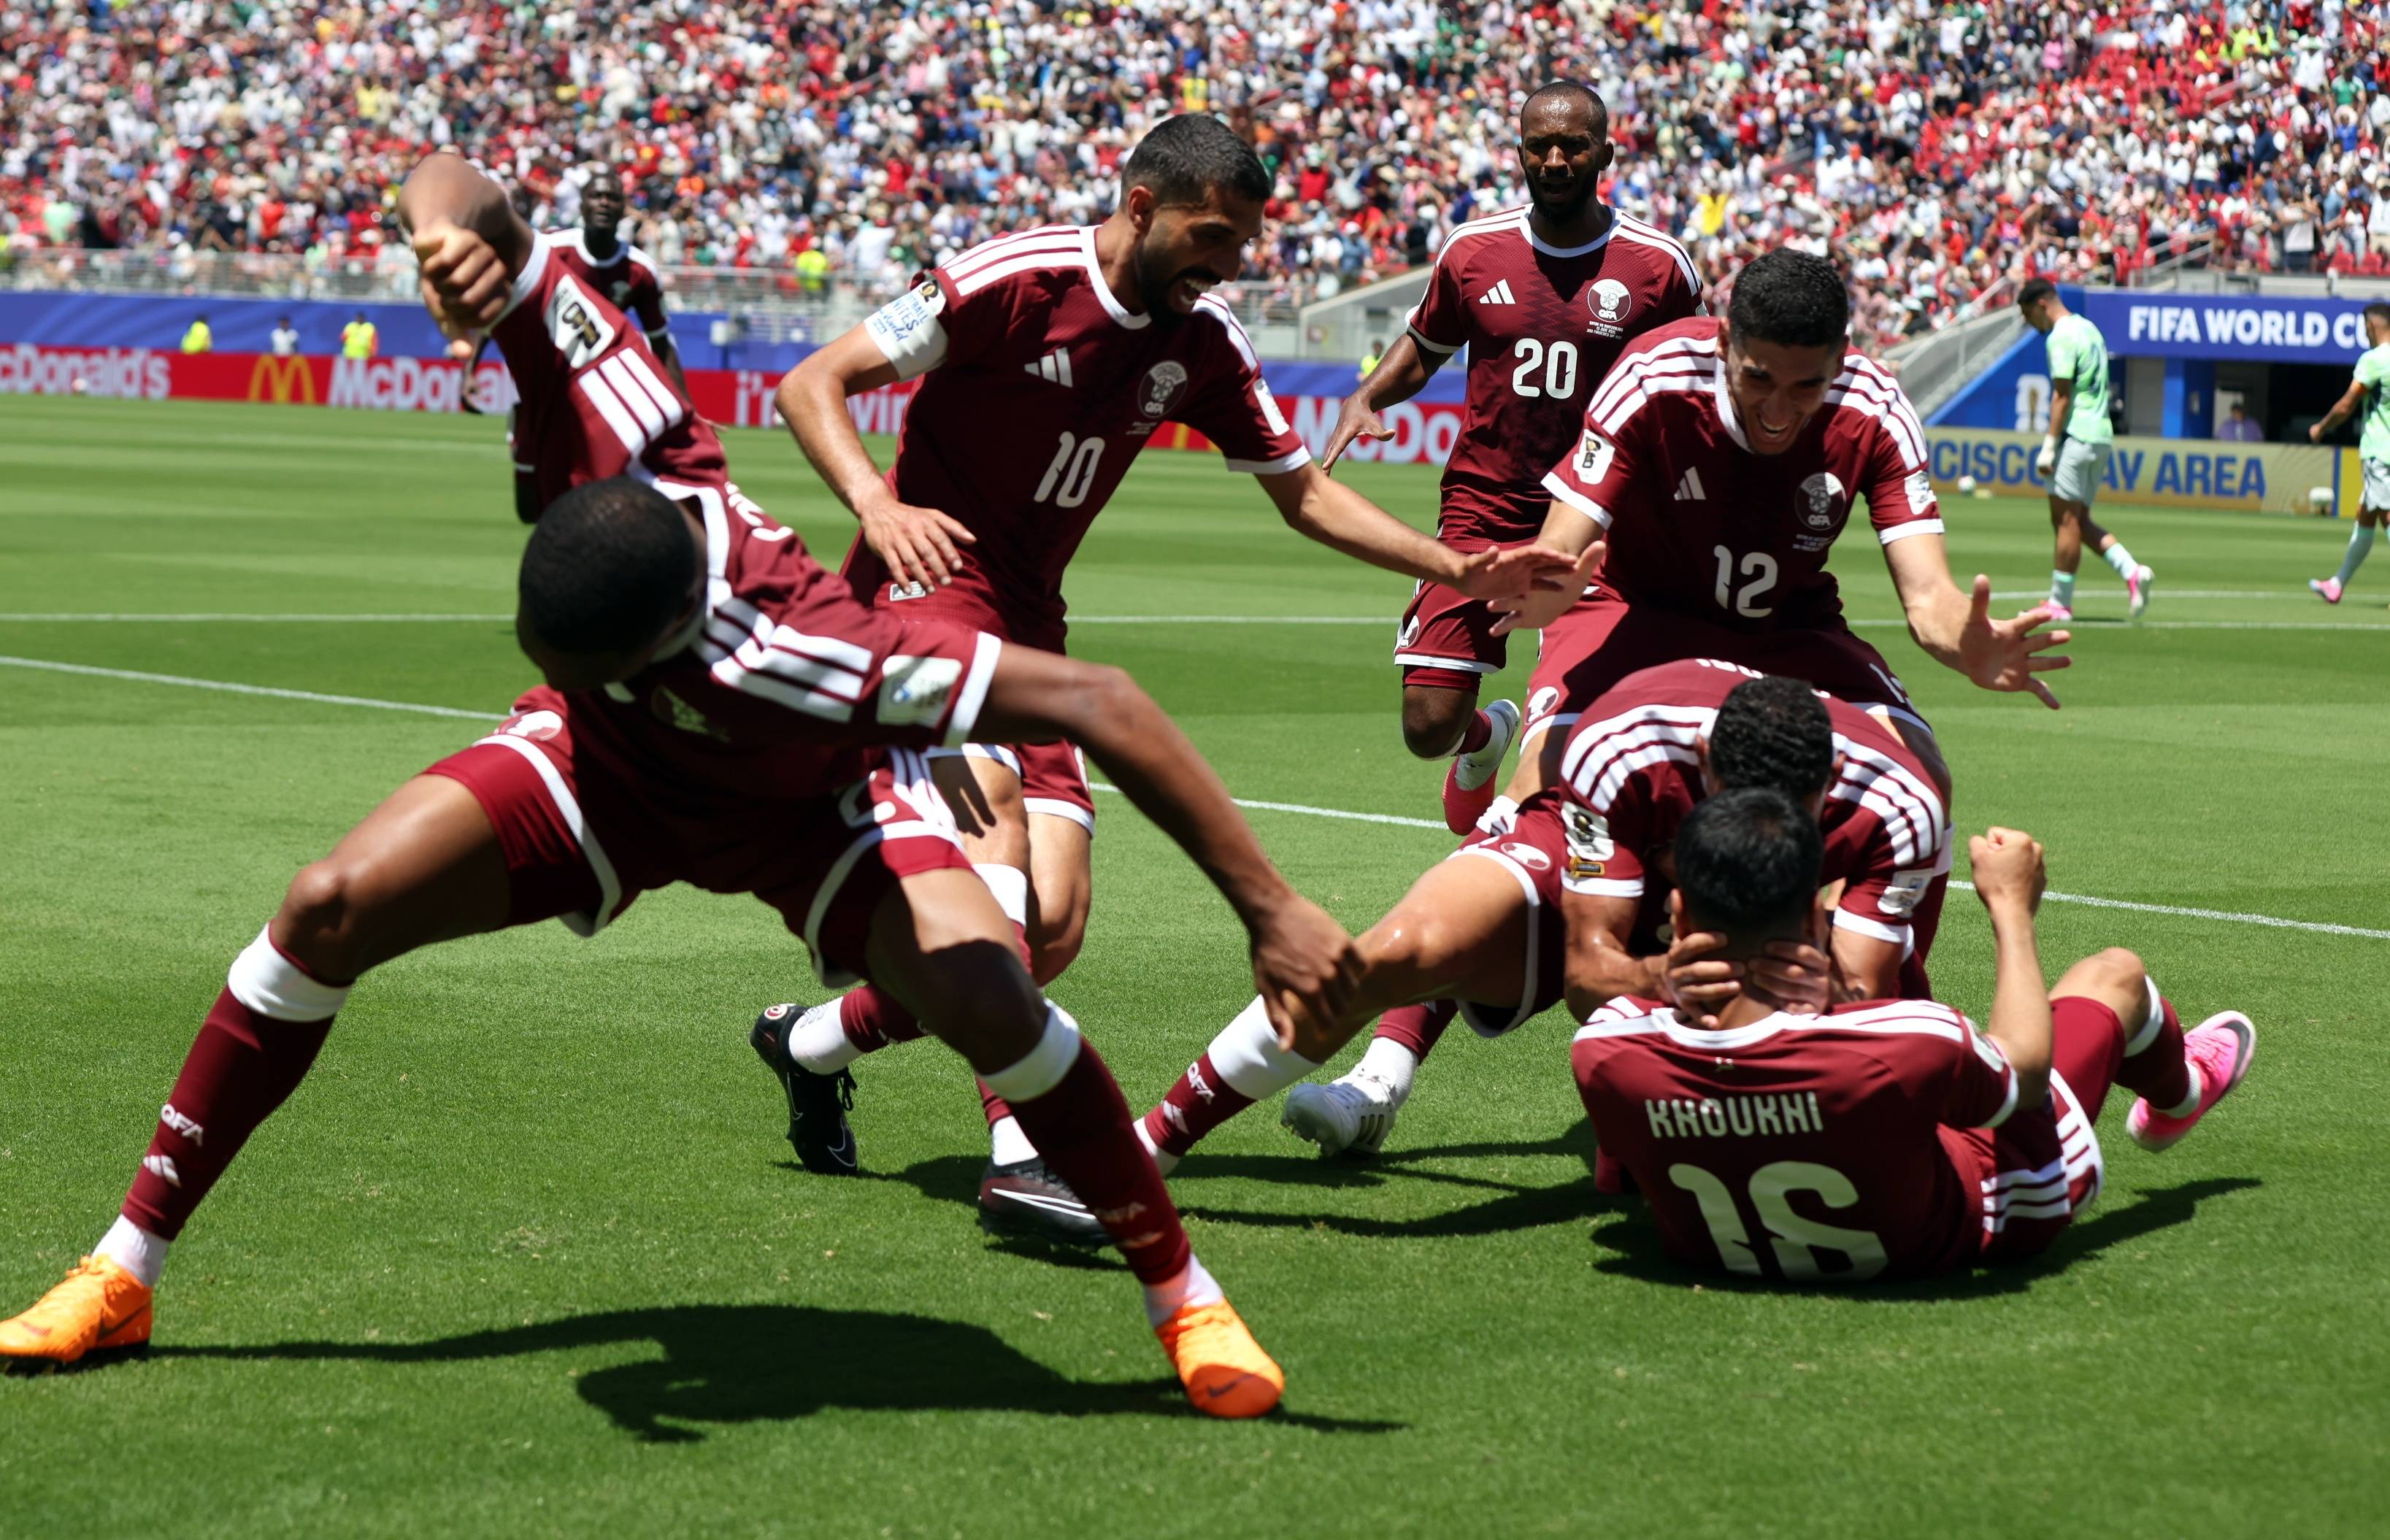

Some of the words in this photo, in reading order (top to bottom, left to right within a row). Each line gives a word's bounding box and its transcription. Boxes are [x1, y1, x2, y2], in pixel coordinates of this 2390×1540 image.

[892, 299, 920, 331] NITES
[2129, 305, 2201, 343] FIFA
[2204, 308, 2329, 347] WORLD
[2333, 312, 2372, 350] CU
[0, 342, 171, 401] cDonald's
[1512, 337, 1578, 399] 20
[1033, 431, 1106, 508] 10
[2099, 450, 2145, 492] AY
[2154, 451, 2267, 499] AREA
[1713, 544, 1778, 618] 12
[1644, 1091, 1824, 1139] KHOUKHI
[1667, 1160, 1889, 1282] 16
